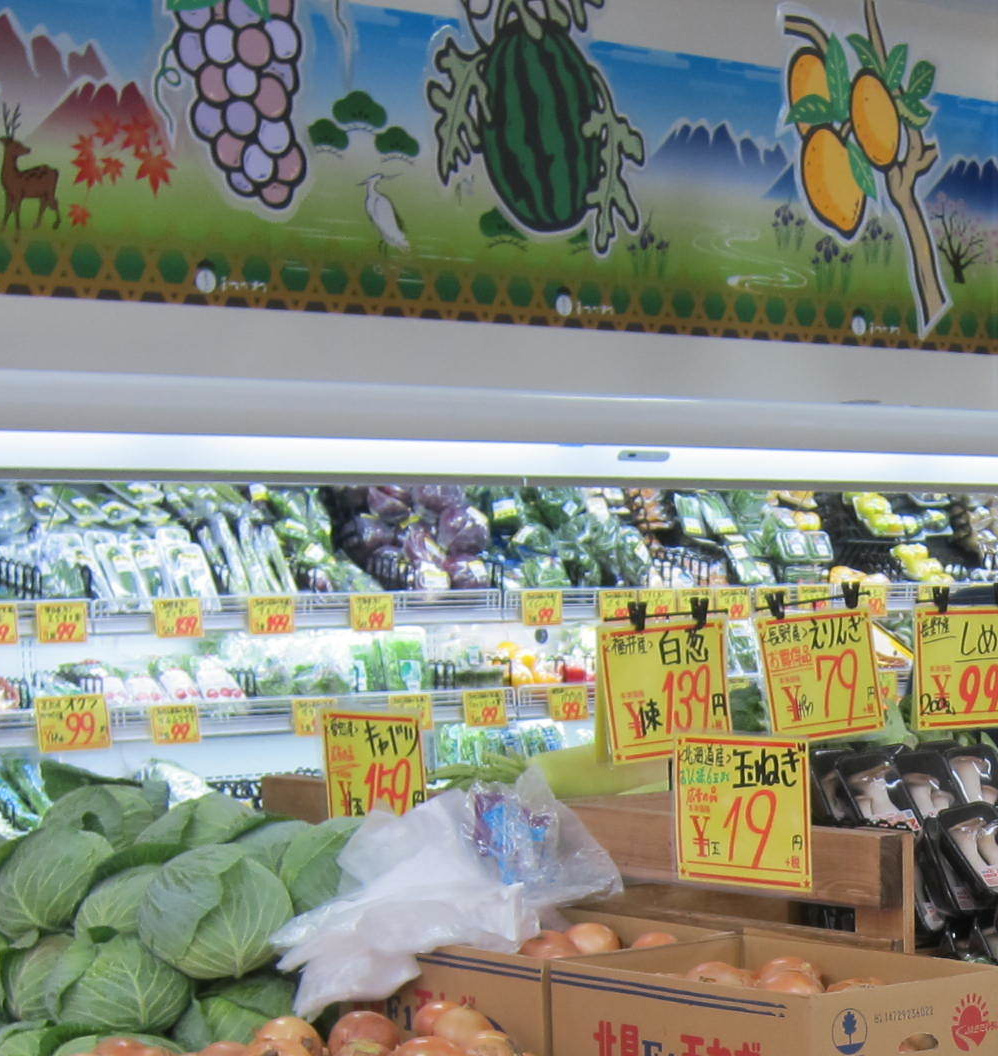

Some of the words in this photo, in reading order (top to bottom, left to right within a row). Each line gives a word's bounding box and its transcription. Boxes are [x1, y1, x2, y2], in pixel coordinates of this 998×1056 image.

[809, 616, 864, 649] えりんぎ
[661, 664, 710, 734] 139
[712, 693, 727, 716] 円
[816, 648, 857, 727] 79
[66, 712, 95, 745] 99
[732, 742, 806, 789] 玉ねぎ
[689, 815, 710, 857] ¥
[722, 789, 778, 869] 19
[792, 834, 803, 850] 円
